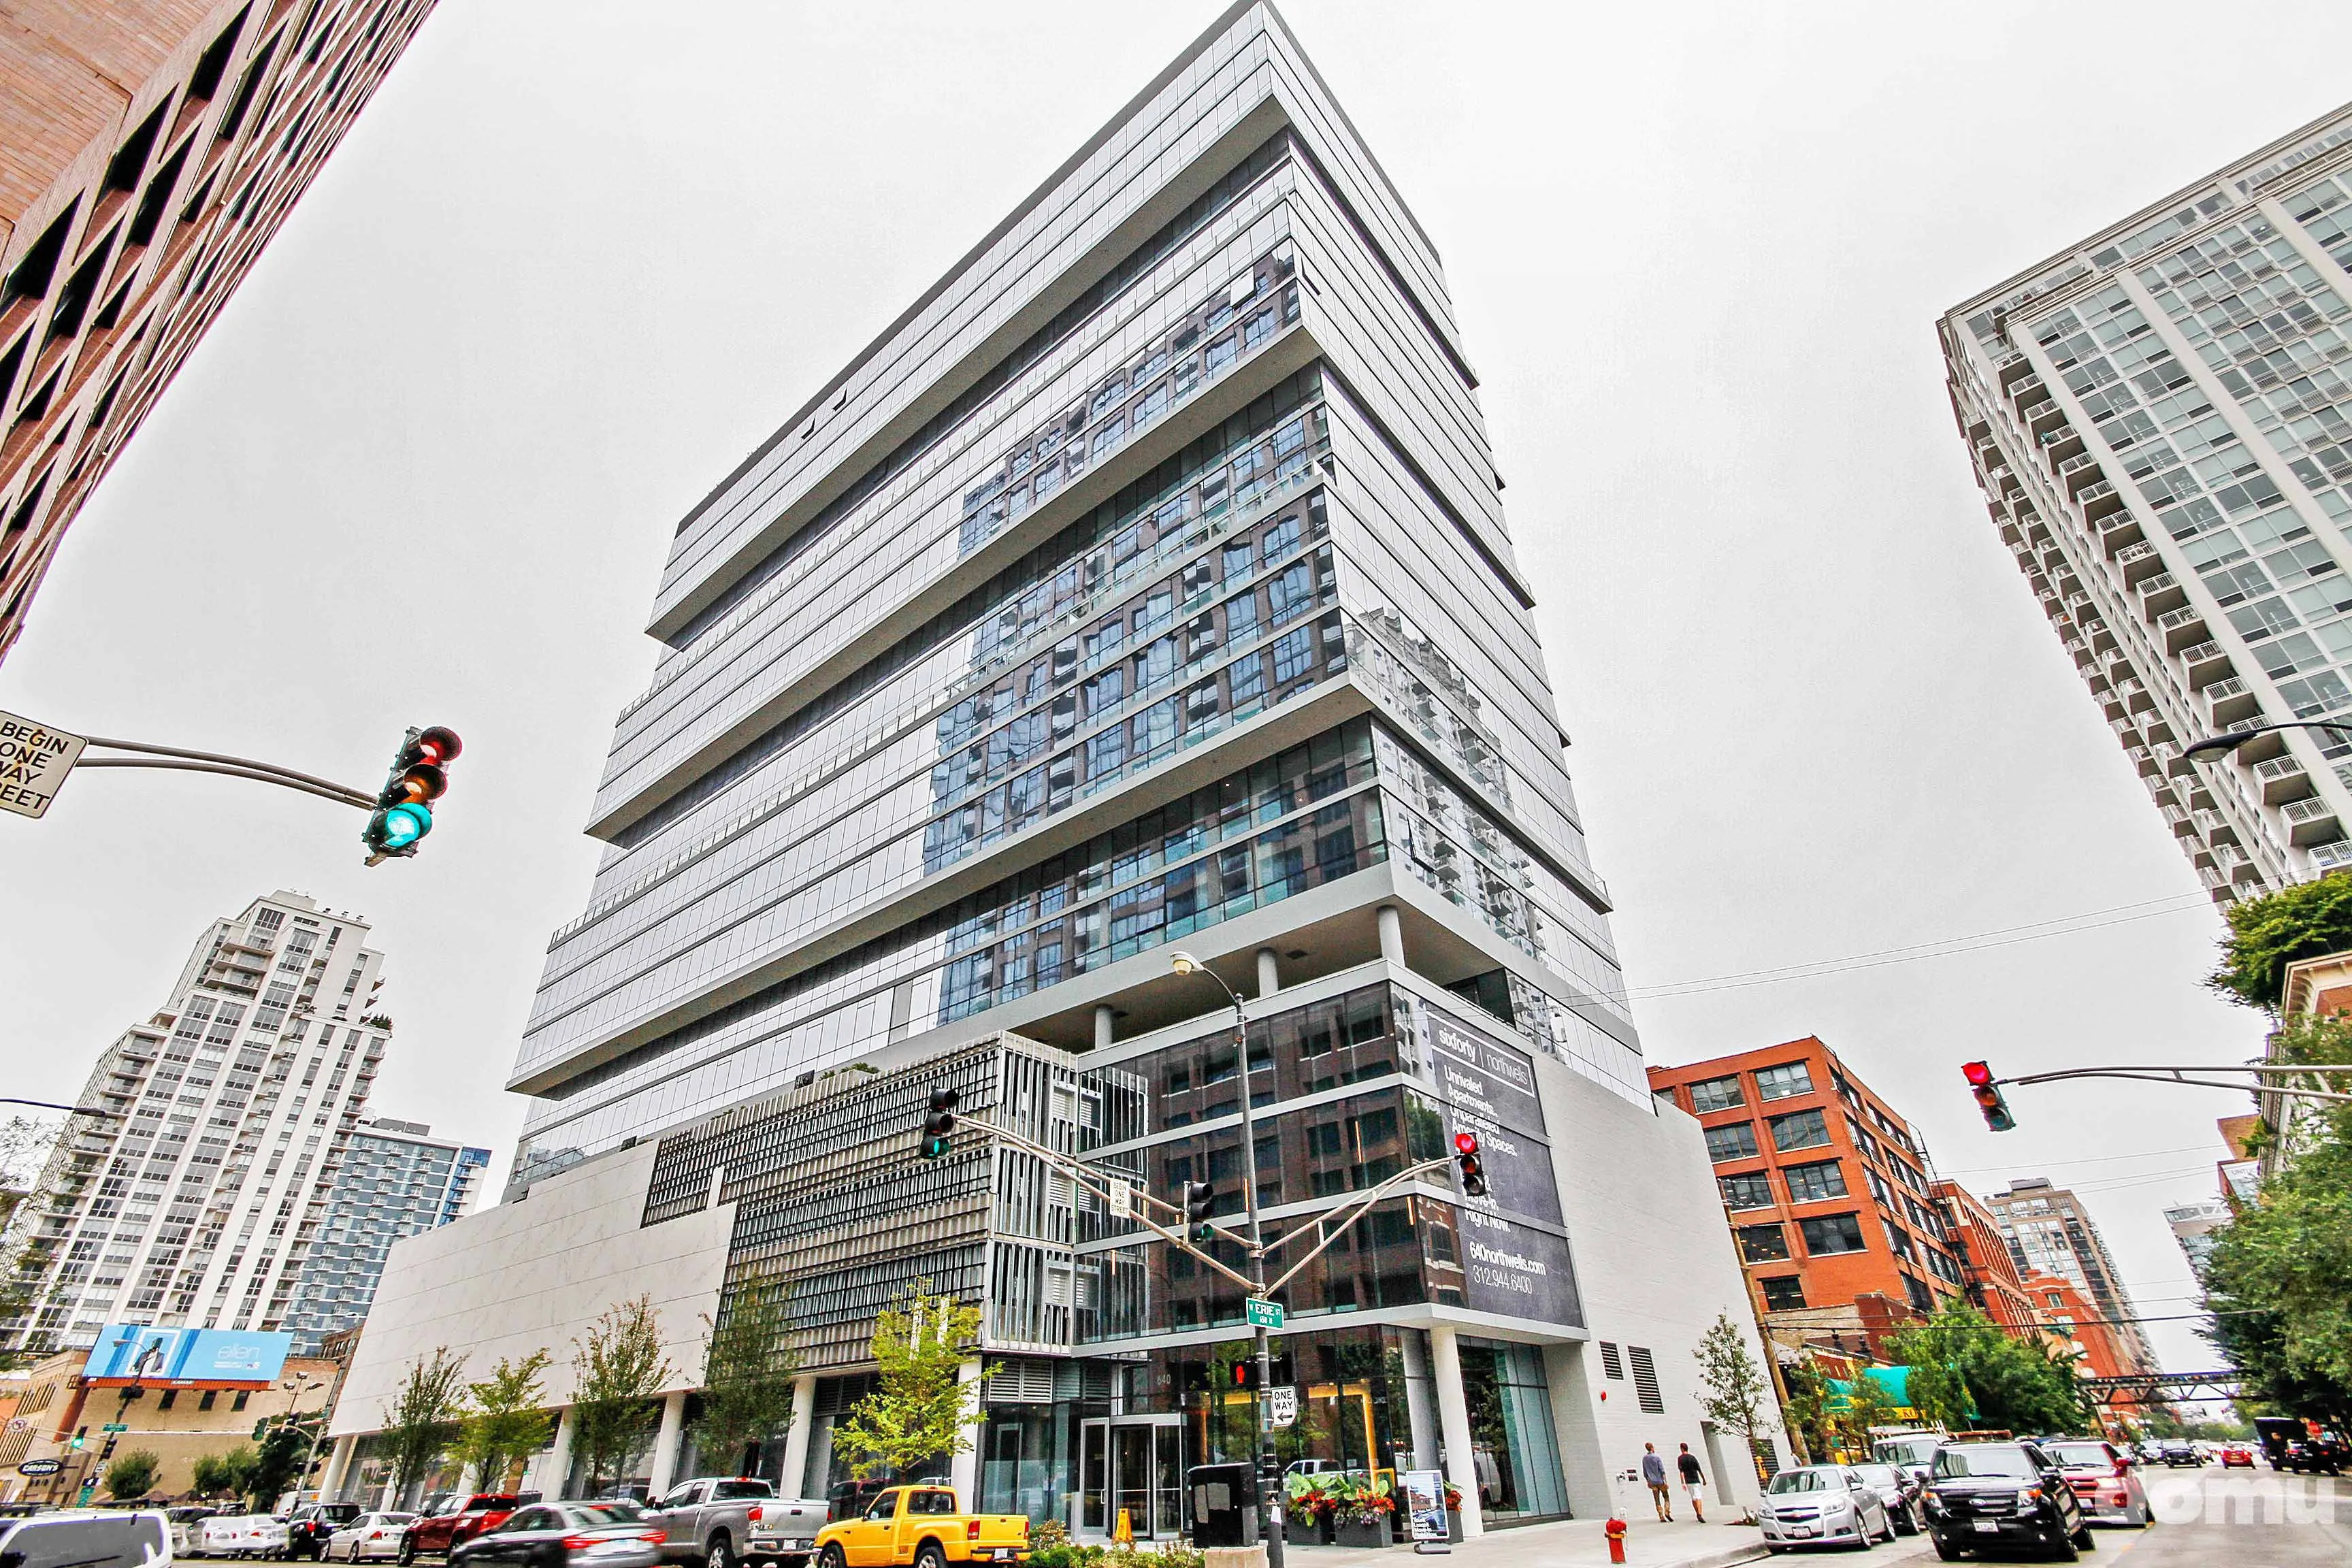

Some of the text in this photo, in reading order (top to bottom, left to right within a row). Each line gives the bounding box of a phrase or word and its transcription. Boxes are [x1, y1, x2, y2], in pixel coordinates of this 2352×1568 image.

[1, 721, 69, 755] BEGIN
[0, 742, 52, 769] ONE
[0, 783, 50, 810] EET
[1439, 1027, 1476, 1062] sixforty
[1443, 1064, 1484, 1096] Unrivaled
[1113, 1181, 1126, 1191] BEGIN
[1115, 1190, 1125, 1198] ONE
[1111, 1205, 1128, 1213] STREET
[1464, 1203, 1490, 1228] Right
[1469, 1241, 1546, 1276] 640northwells.com
[1473, 1264, 1533, 1294] 312.944.6400
[1255, 1303, 1275, 1317] ERIE
[1274, 1390, 1292, 1400] ONE
[1275, 1401, 1293, 1411] WAY
[22, 1464, 59, 1472] CARSON'S
